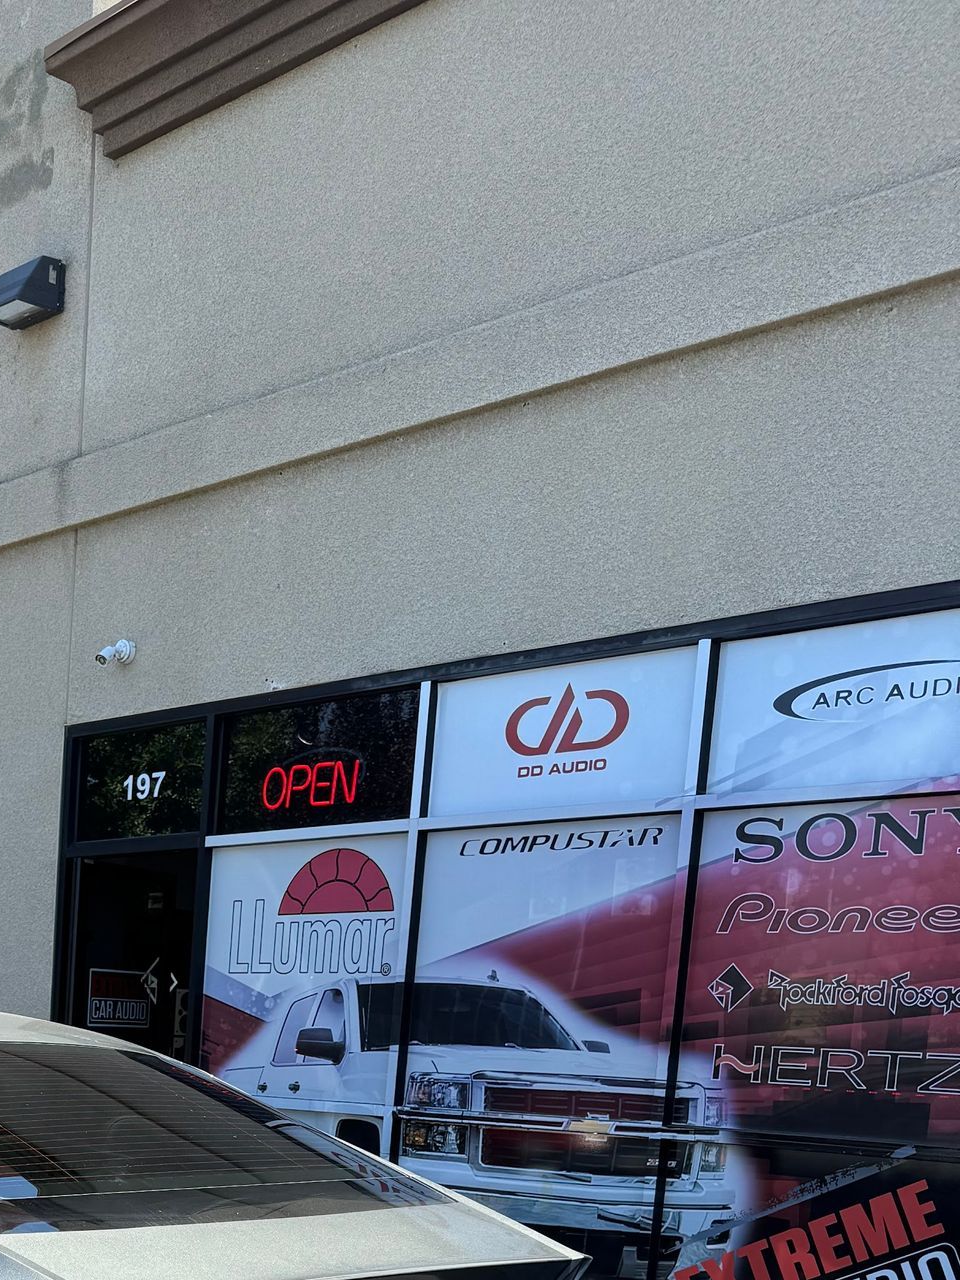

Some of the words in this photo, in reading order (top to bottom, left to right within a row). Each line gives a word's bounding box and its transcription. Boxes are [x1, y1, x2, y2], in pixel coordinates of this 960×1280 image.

[811, 686, 875, 710] ARC
[517, 765, 543, 778] DD
[548, 758, 608, 775] AUDIO
[123, 771, 166, 801] 197
[262, 759, 360, 811] OPEN
[459, 827, 663, 857] COMPUSTAR
[92, 1000, 113, 1019] CAR
[115, 1001, 146, 1020] AUDIO
[711, 1044, 960, 1095] HERTZ
